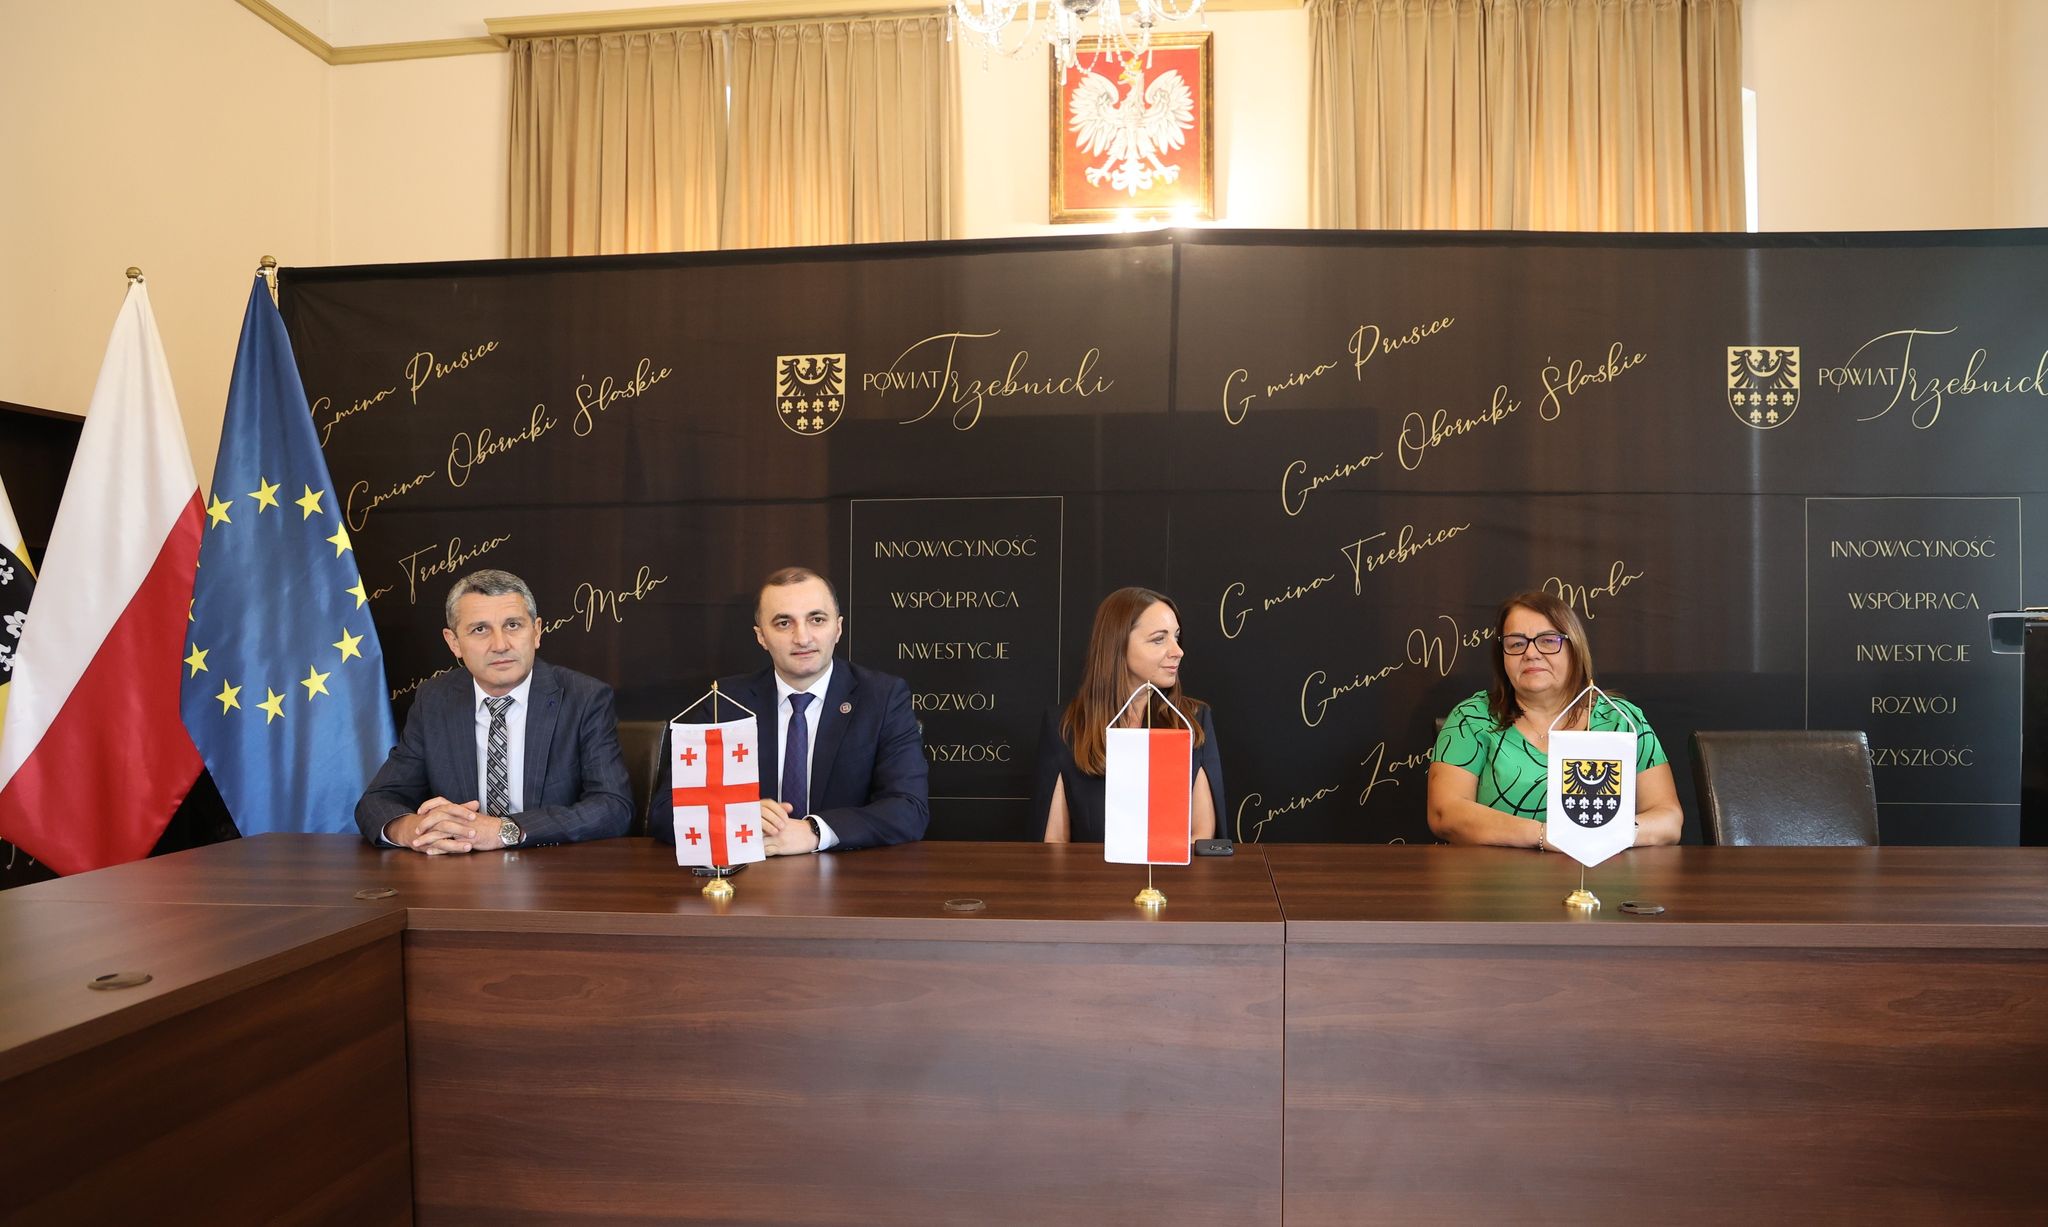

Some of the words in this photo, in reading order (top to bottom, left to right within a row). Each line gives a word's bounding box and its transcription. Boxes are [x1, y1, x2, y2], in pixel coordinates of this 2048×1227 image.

[863, 370, 942, 391] POWIAT
[881, 328, 1114, 431] Trzebnicki
[1222, 361, 1338, 425] Gmina
[1348, 314, 1455, 381] Prusice
[1818, 367, 1899, 387] POWIAT
[1838, 326, 2048, 429] Trzebnick
[310, 386, 396, 448] Gmina
[405, 340, 499, 405] Prusice
[1281, 451, 1384, 517] Gmina
[1397, 384, 1521, 471] Oborniki
[346, 470, 435, 532] Gmina
[447, 403, 557, 487] Oborniki
[874, 534, 1038, 559] INNOWACYJNOŚĆ
[1831, 535, 1996, 559] INNOWACYJNOŚĆ
[398, 533, 511, 605] Trzebnica
[1219, 573, 1335, 640] Gmina
[1340, 522, 1471, 596] Trzebnica
[574, 564, 668, 633] Mała
[890, 588, 1020, 609] WSPÓŁPRACA
[1848, 588, 1980, 611] WSPÓŁPRACA
[897, 641, 1010, 660] INWESTYCJE
[1301, 660, 1404, 728] Gmina
[1406, 614, 1497, 677] Wisz
[1541, 560, 1645, 620] Mała
[1856, 643, 1971, 663] INWESTYCJE
[390, 664, 454, 700] mina
[911, 690, 996, 712] ROZWÓJ
[1871, 693, 1957, 715] ROZWÓJ
[923, 738, 1012, 763] YSZŁOŚĆ
[1868, 744, 1975, 768] RZYSZŁOŚĆ
[1236, 784, 1340, 844] Gmina
